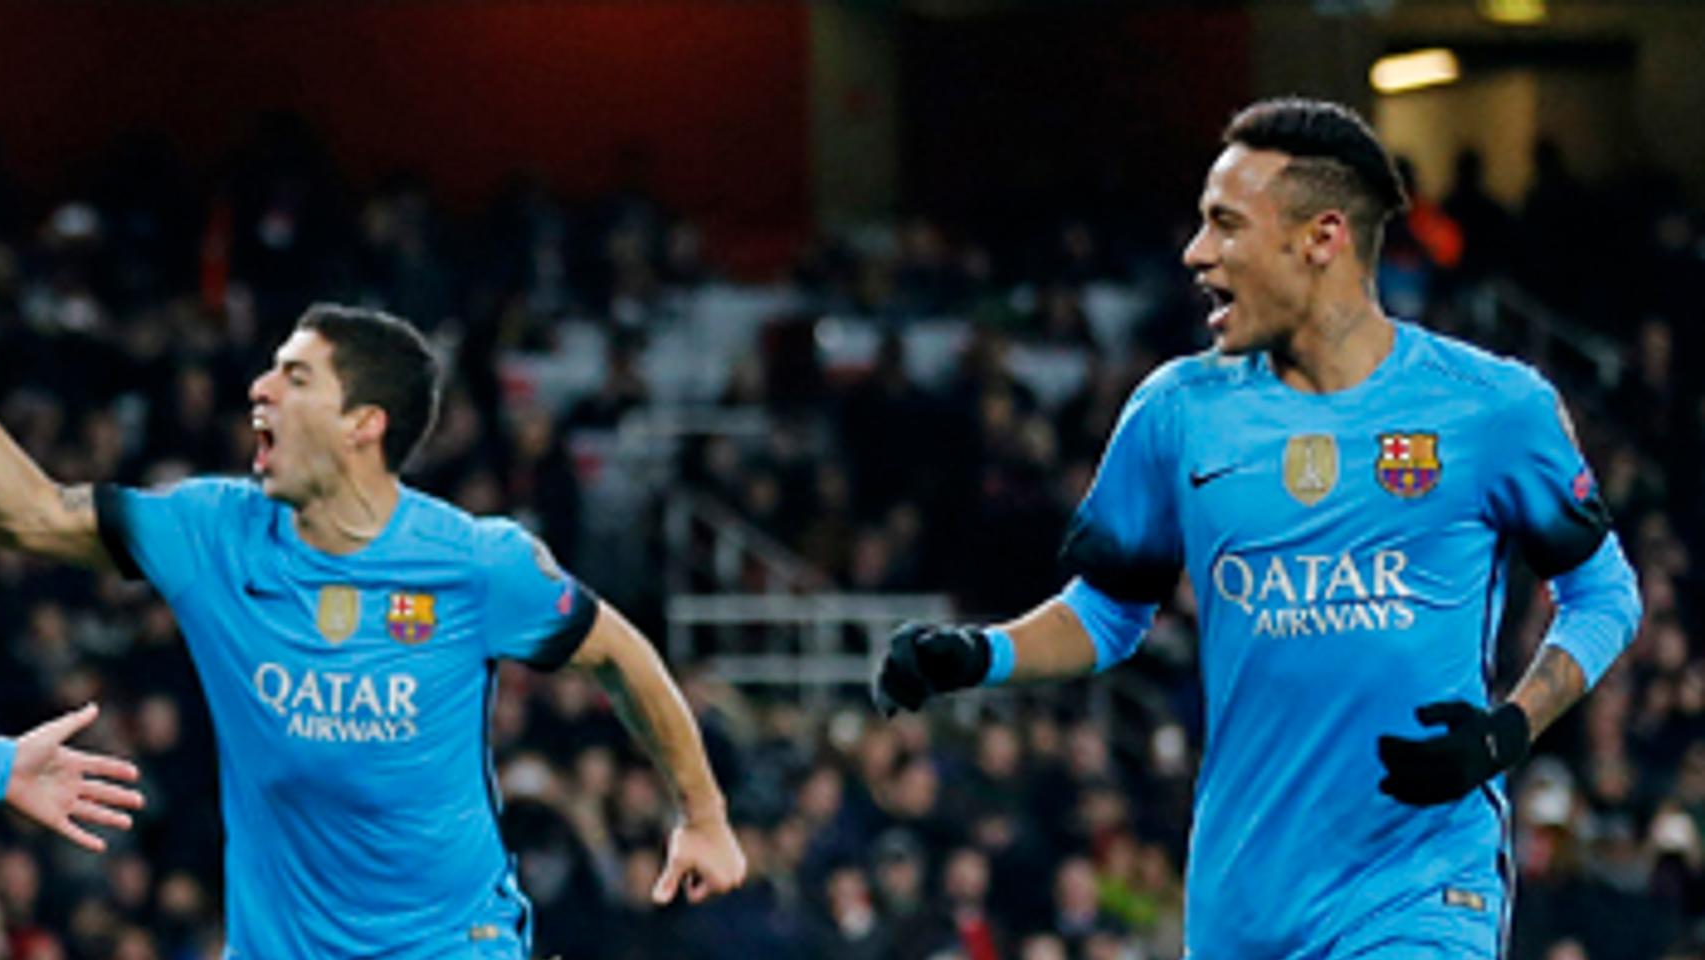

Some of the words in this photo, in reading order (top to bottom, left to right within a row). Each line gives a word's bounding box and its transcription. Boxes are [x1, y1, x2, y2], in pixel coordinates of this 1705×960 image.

[1213, 549, 1412, 615] QATAR
[1253, 599, 1415, 638] AIRWAYS
[254, 662, 418, 717] QATAR
[287, 711, 418, 742] AIRWAYS
